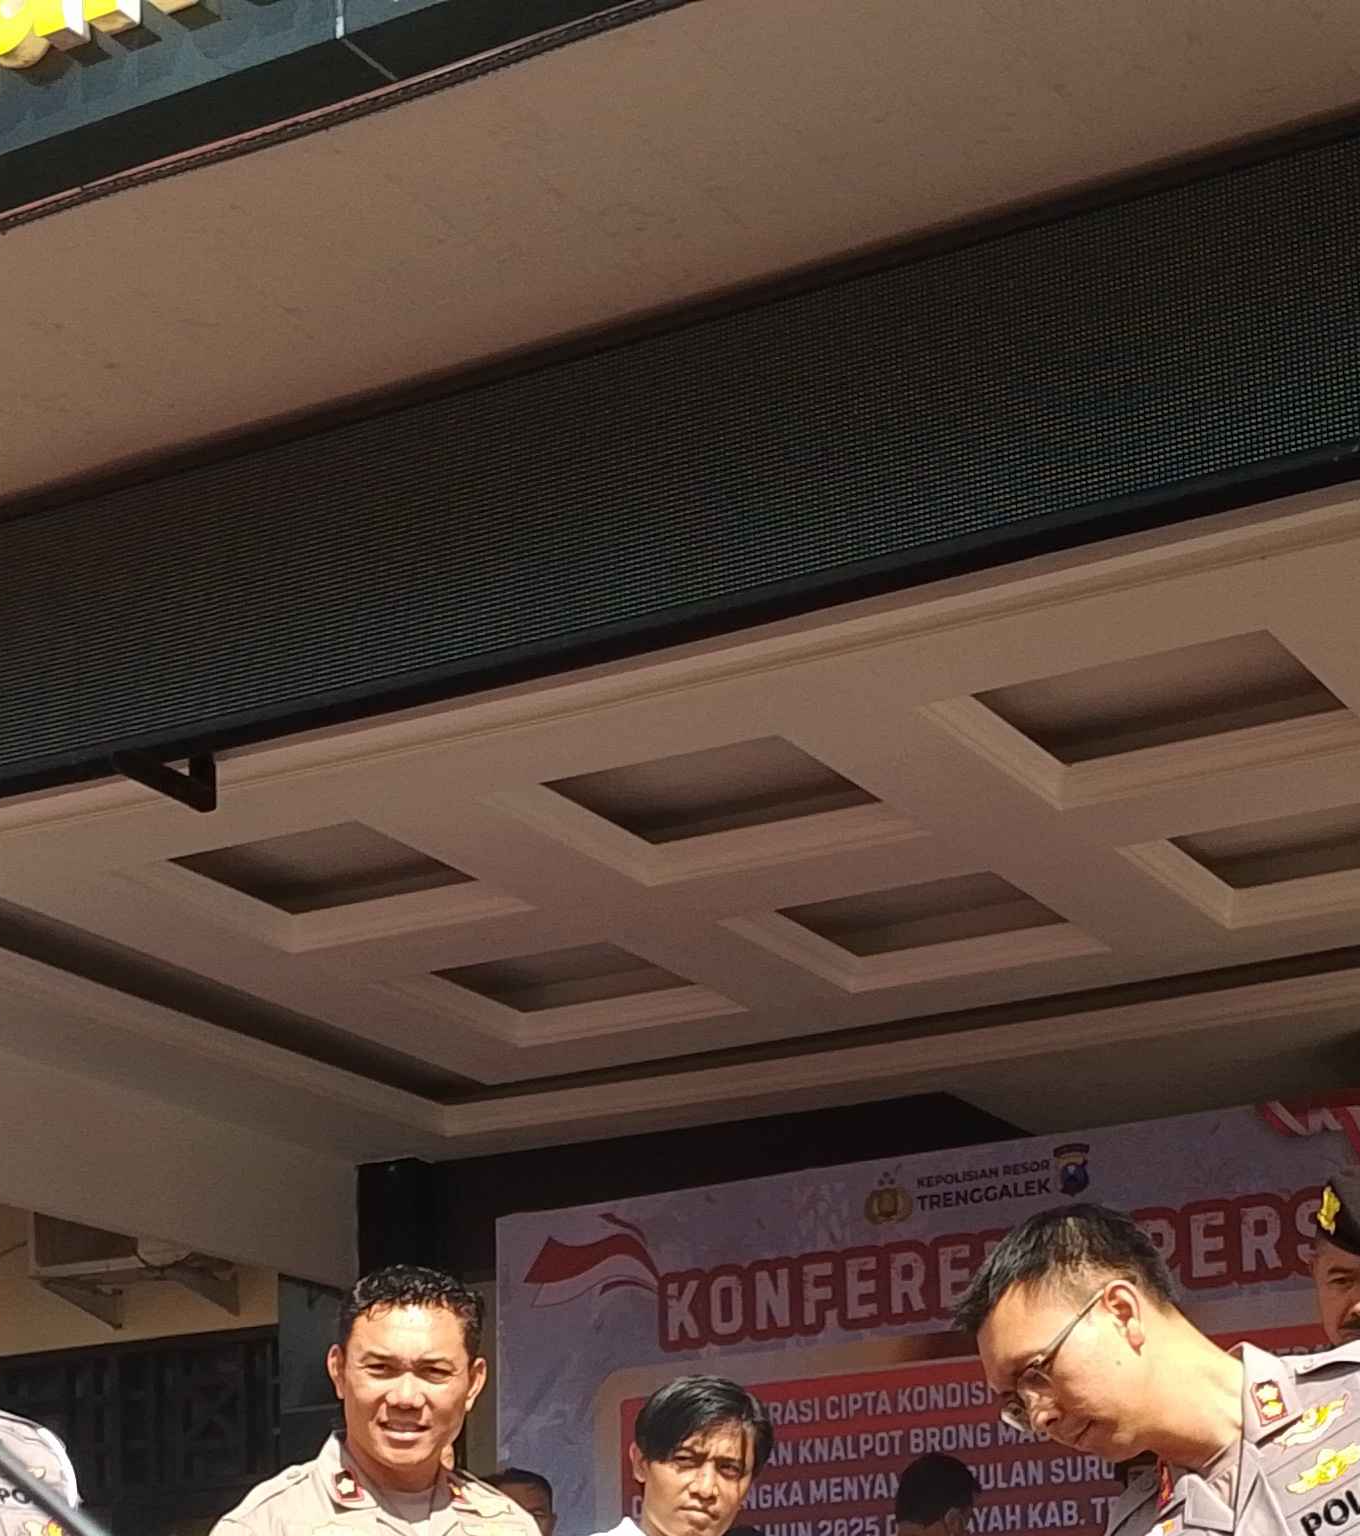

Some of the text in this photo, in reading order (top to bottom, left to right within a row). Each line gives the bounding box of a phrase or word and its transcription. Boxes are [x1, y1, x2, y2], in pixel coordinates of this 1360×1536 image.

[917, 1159, 1051, 1189] KEPOLISIAN RESOR
[916, 1177, 1052, 1211] TRENGGALEK
[667, 1240, 996, 1341] KONFERE
[825, 1389, 892, 1420] CIPTA
[798, 1429, 904, 1465] KNALPOT
[909, 1422, 993, 1454] BRONG
[1027, 1500, 1087, 1529] KAB.
